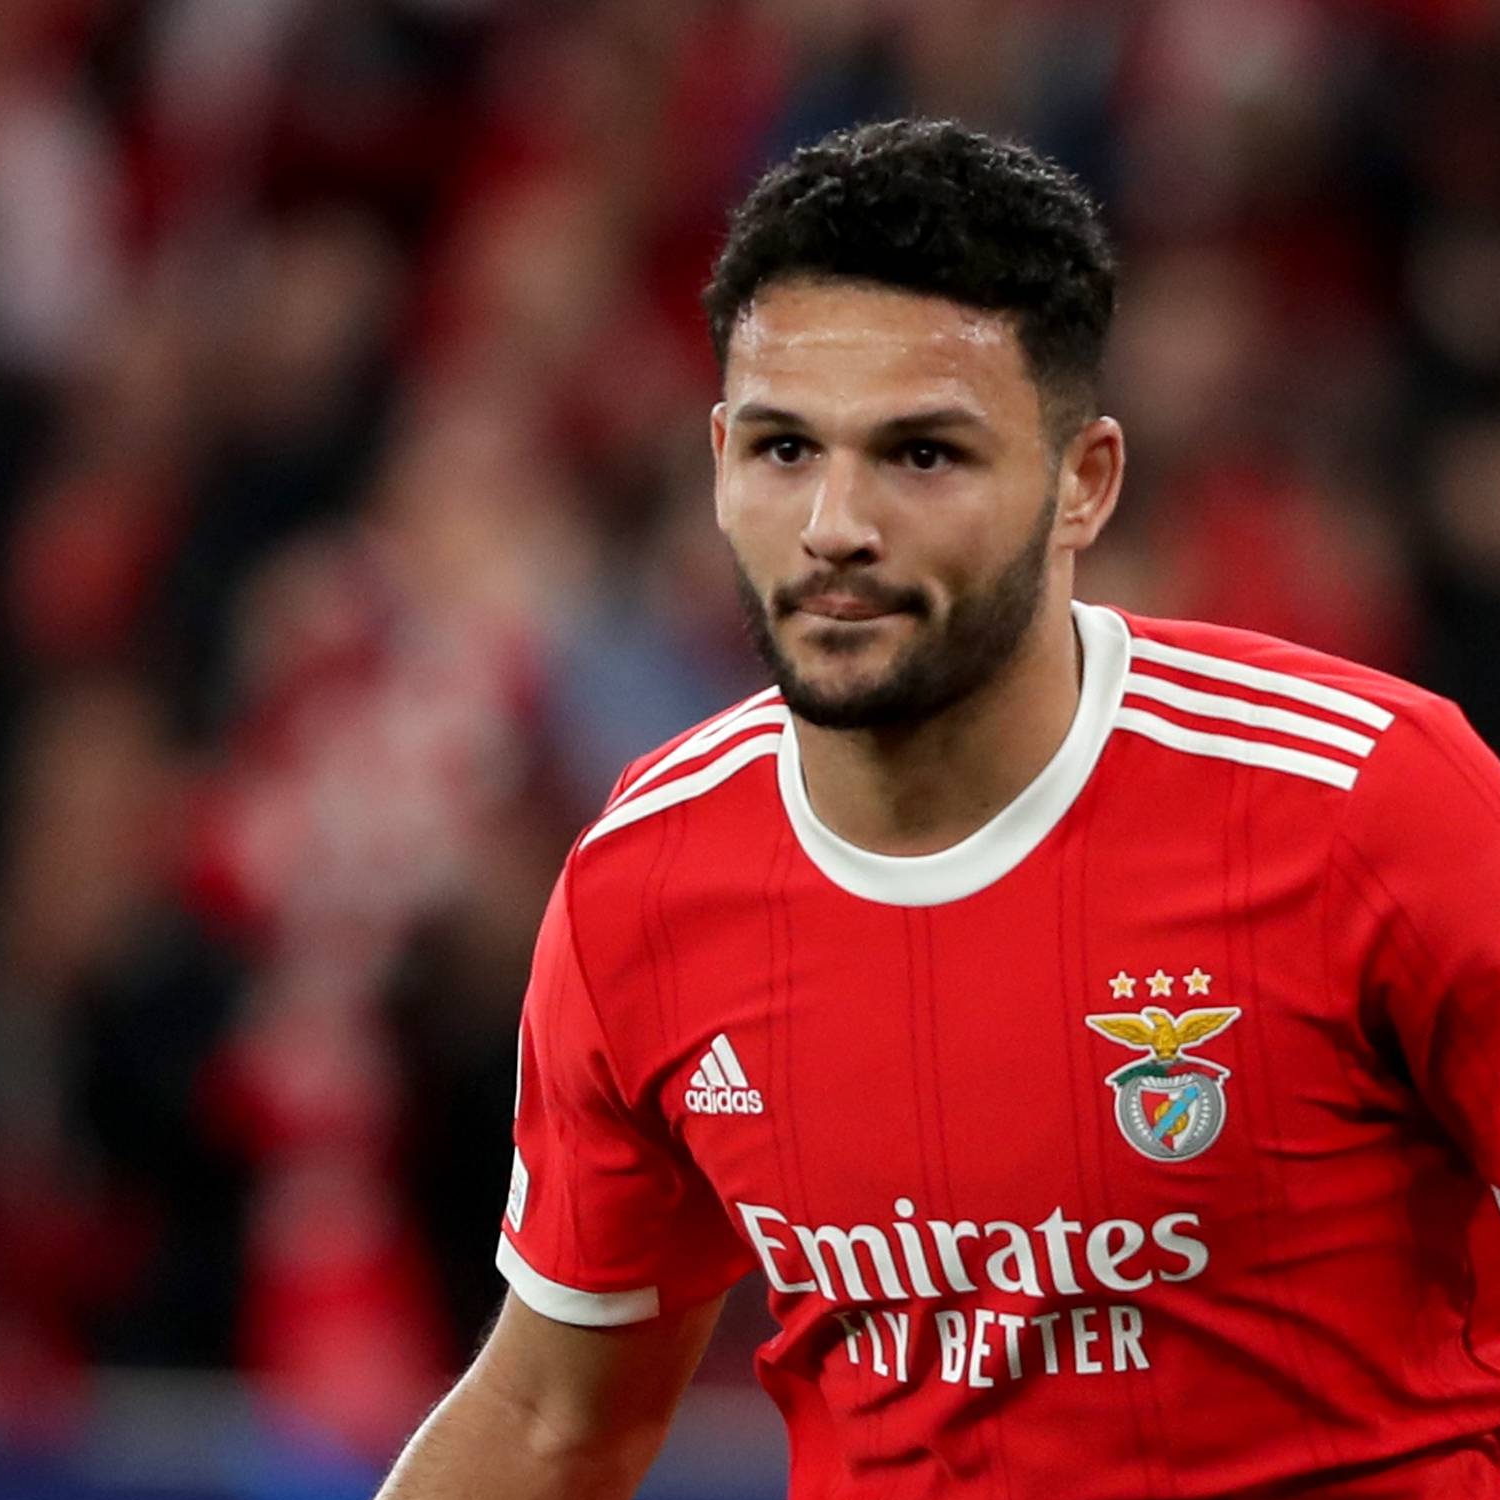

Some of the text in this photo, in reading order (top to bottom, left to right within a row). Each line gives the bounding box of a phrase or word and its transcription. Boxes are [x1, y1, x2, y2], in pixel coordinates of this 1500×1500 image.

[684, 1086, 764, 1115] adidas
[735, 1197, 1209, 1301] Emirates
[837, 1304, 1151, 1388] FLY BETTER
